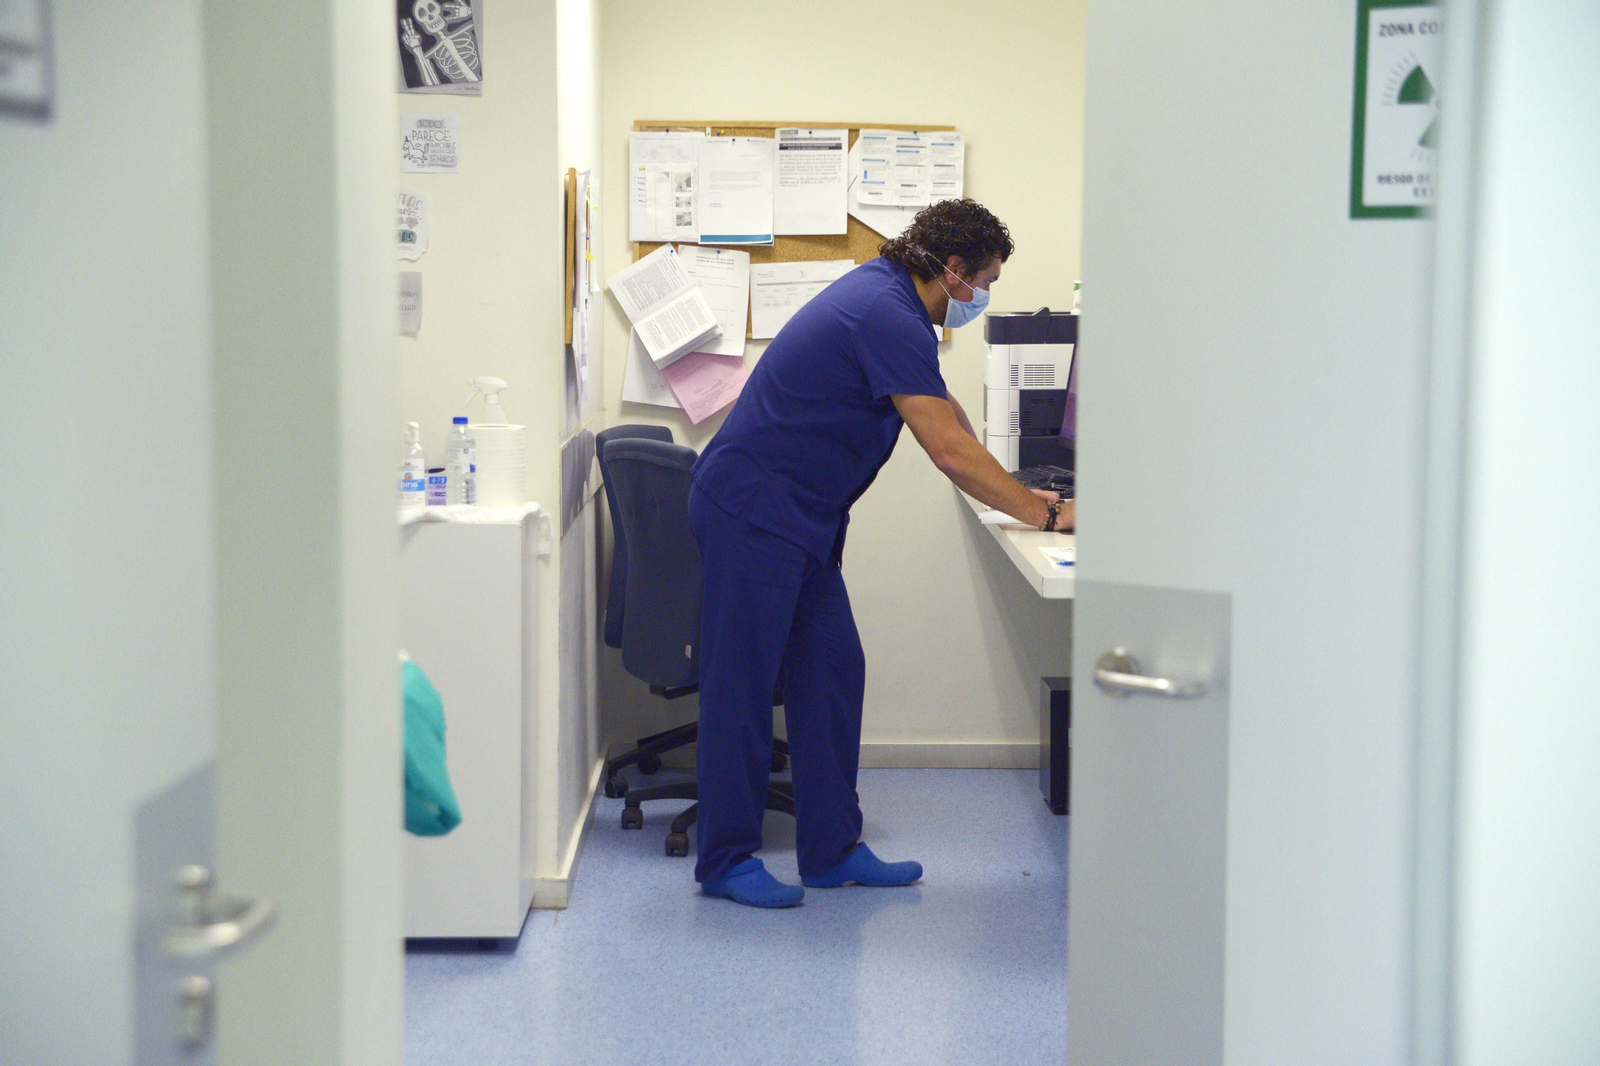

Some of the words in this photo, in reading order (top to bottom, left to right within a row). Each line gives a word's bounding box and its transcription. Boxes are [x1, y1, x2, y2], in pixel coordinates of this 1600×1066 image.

[1379, 22, 1414, 37] ZONA
[418, 119, 442, 128] TODO
[412, 129, 450, 141] PARECE
[1377, 174, 1413, 185] RIESGO
